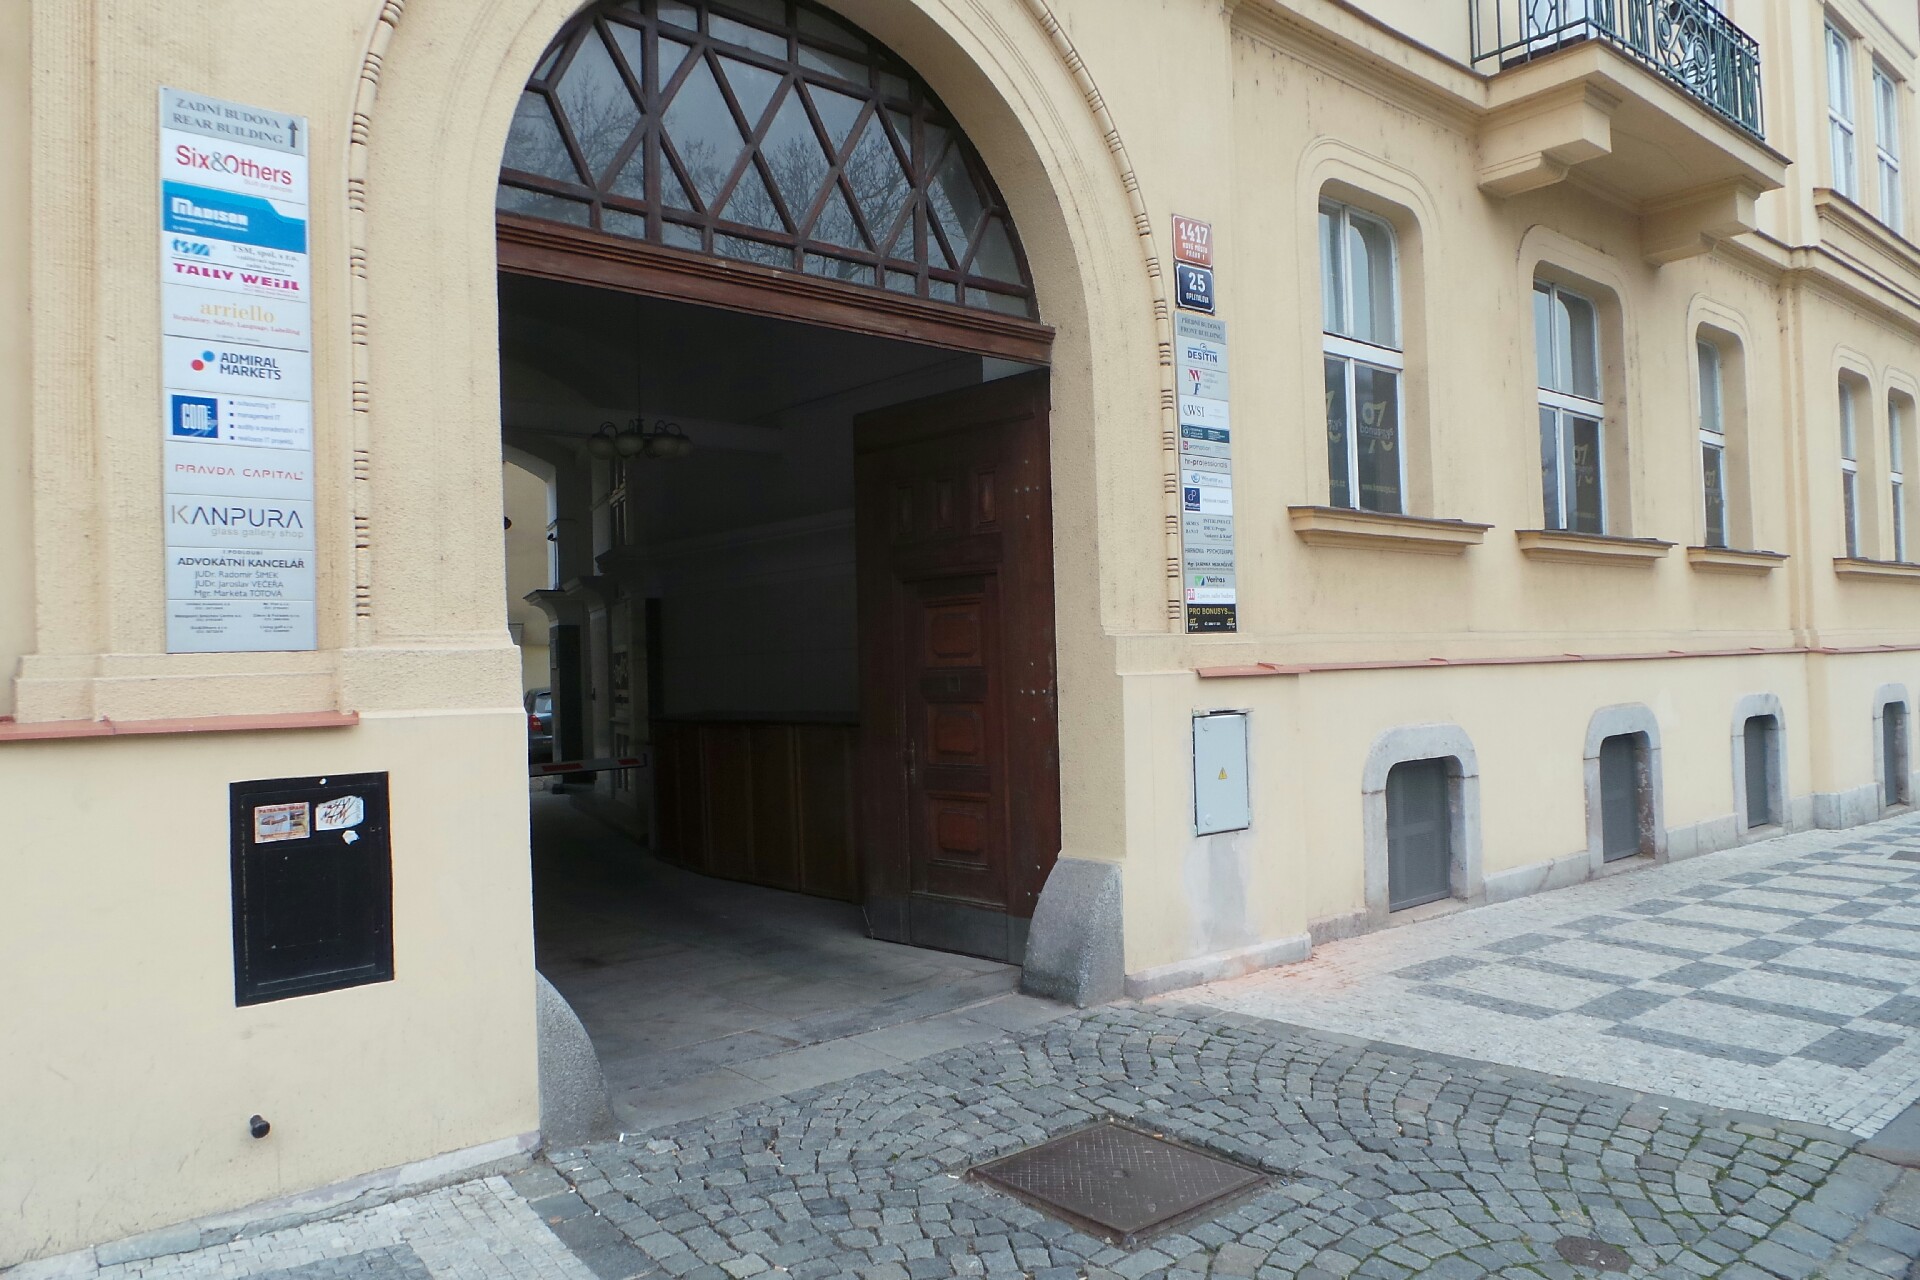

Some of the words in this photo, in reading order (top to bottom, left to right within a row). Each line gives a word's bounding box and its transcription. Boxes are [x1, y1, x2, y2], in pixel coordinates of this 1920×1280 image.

[176, 98, 221, 115] ZADNÍ
[225, 109, 280, 129] BUDOVA
[173, 113, 213, 130] REAR
[217, 121, 284, 144] BUILDING
[176, 145, 292, 186] Six&Others
[1179, 221, 1208, 245] 1417
[1182, 242, 1194, 251] NOVÉ
[173, 263, 234, 281] TALLY
[1188, 272, 1206, 293] 25
[200, 302, 275, 324] arriello
[220, 352, 279, 368] ADMIRAL
[1187, 350, 1218, 363] DESITIN
[219, 364, 282, 381] MARKETS
[1362, 400, 1387, 428] 07
[175, 463, 235, 476] PRAVDA
[242, 468, 303, 481] CAPITAL
[171, 504, 304, 528] KANPURA
[211, 527, 239, 537] glass
[242, 528, 277, 539] gallery
[279, 529, 304, 539] shop
[177, 556, 245, 567] ADVOKÁTNÍ
[248, 557, 305, 569] KANCELÁŘ
[195, 570, 216, 579] JUDr.
[195, 580, 216, 589] JUDr.
[218, 580, 249, 588] Jaroslav
[193, 590, 211, 599] Mgr.
[1188, 607, 1201, 615] PRO
